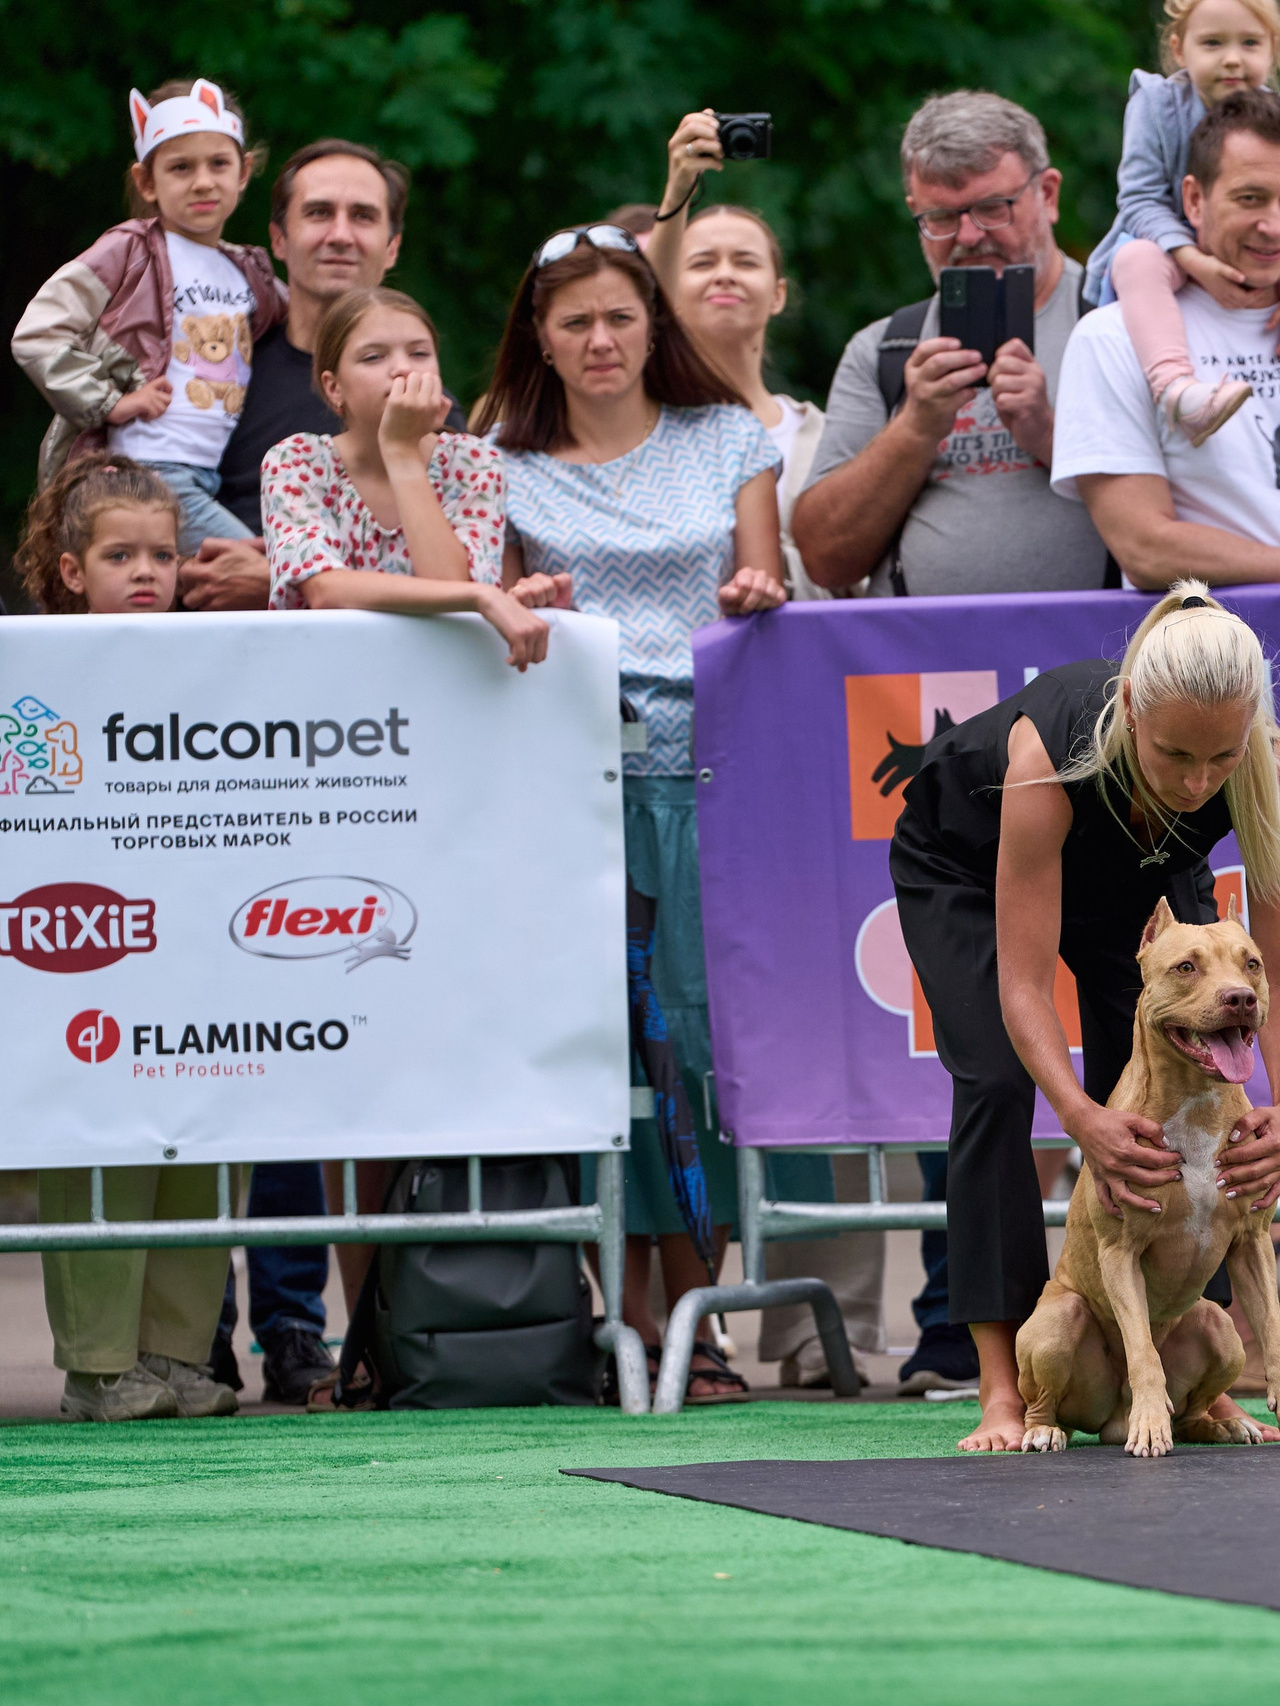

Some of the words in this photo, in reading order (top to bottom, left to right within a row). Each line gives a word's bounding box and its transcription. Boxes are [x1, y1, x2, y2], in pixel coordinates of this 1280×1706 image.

[978, 447, 1024, 464] LISTE
[102, 707, 410, 768] falconpet
[105, 780, 172, 795] товары
[177, 780, 210, 793] для
[215, 776, 310, 792] домашних
[315, 775, 407, 788] животных
[0, 812, 140, 833] ФИЦИАЛЬНЫЙ
[147, 811, 313, 829] ПРЕДСТАВИТЕЛЬ
[319, 811, 331, 825] В
[337, 809, 418, 824] РОССИИ
[111, 834, 217, 850] ТОРГОВЫХ
[223, 832, 292, 847] МАРОК
[244, 895, 378, 938] flexi
[133, 1019, 349, 1055] FLAMINGO
[133, 1063, 165, 1078] Pet
[175, 1061, 265, 1077] Products
